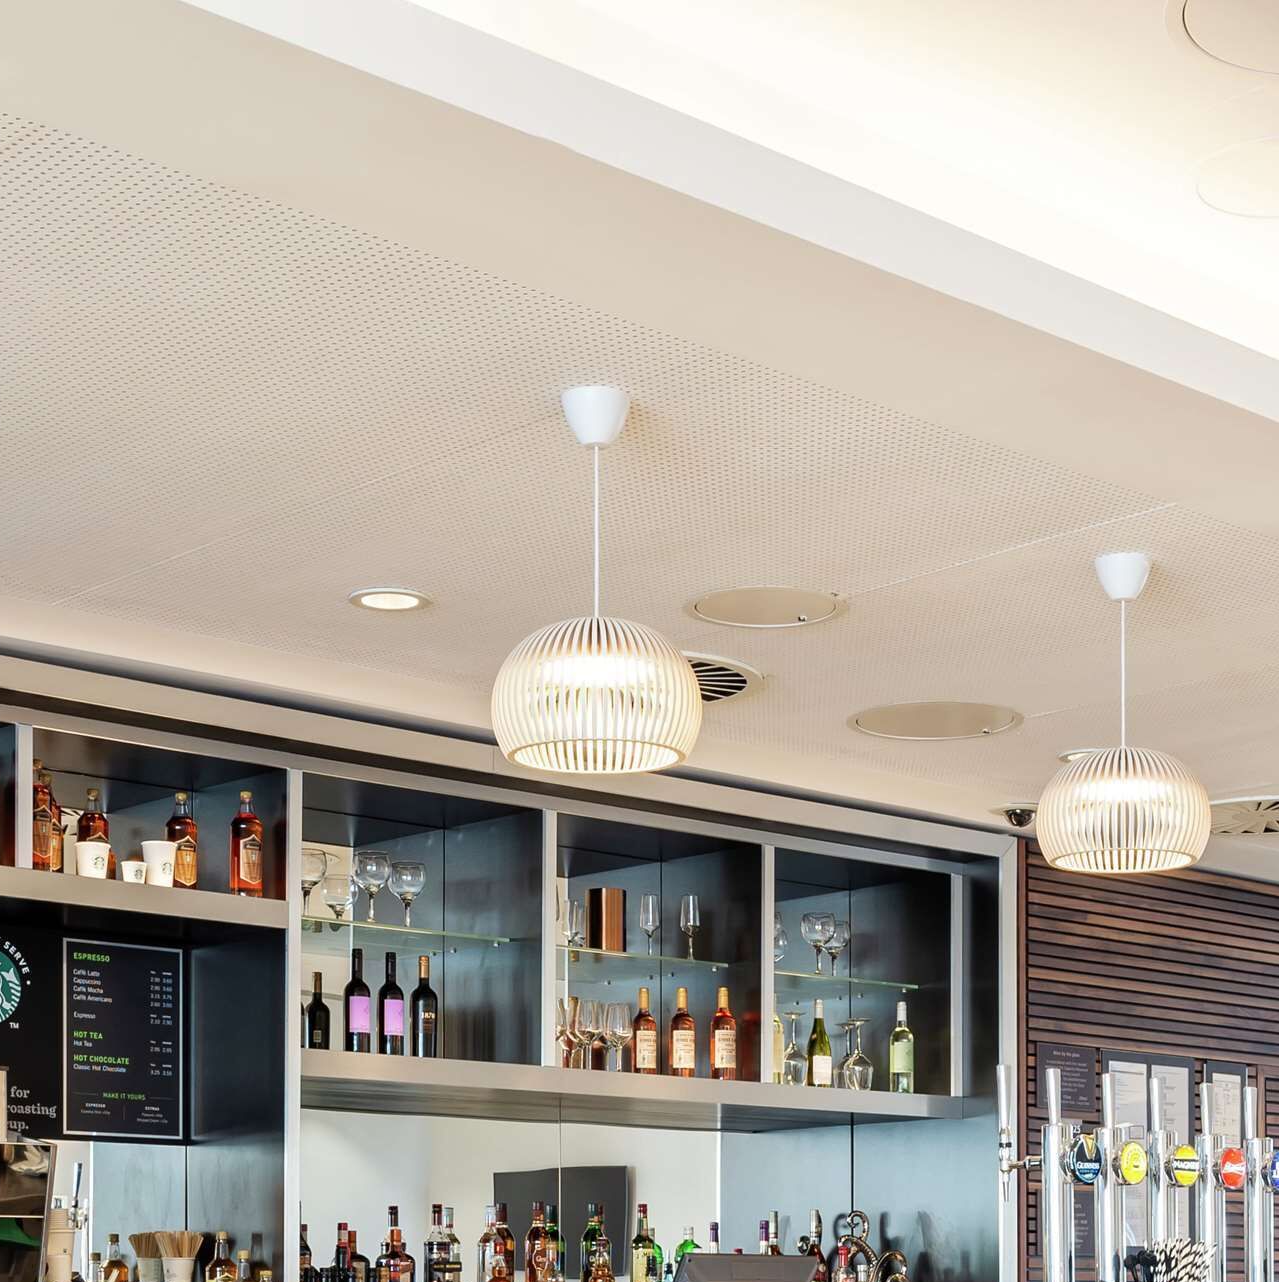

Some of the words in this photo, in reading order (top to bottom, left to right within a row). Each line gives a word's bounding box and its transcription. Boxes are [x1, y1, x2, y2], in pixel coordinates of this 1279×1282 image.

[3, 941, 30, 975] SERVE
[73, 952, 110, 962] ESPRESSO
[73, 1031, 87, 1039] HOT
[89, 1032, 103, 1040] TEA
[73, 1054, 87, 1062] HOT
[89, 1055, 130, 1065] CHOCOLATE
[10, 1086, 30, 1098] for
